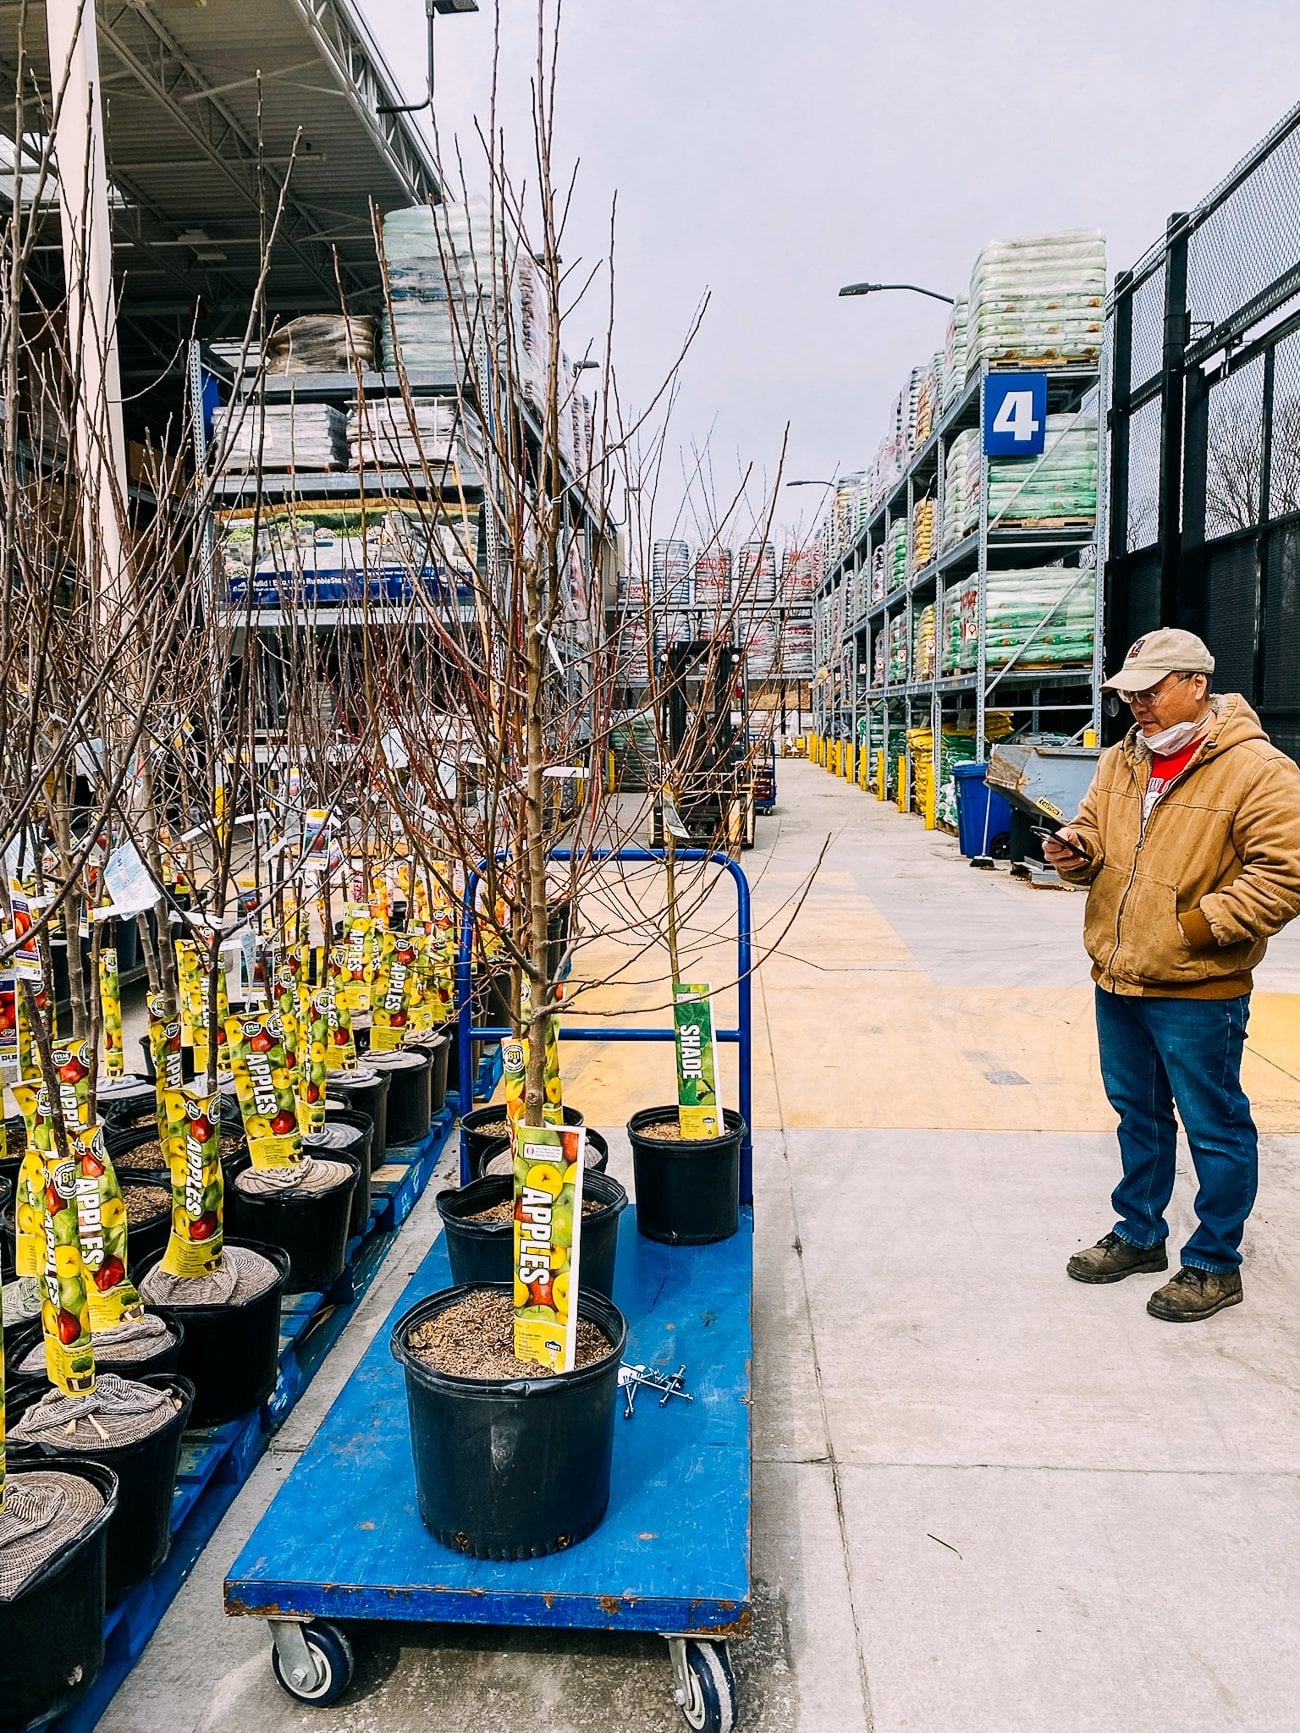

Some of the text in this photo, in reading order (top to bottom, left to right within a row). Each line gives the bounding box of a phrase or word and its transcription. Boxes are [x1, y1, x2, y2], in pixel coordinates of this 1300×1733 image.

[993, 391, 1040, 441] 4
[384, 961, 406, 1012] APPLES
[508, 1051, 519, 1060] 811
[680, 1024, 703, 1080] SHADE
[247, 1053, 278, 1115] APPLES
[185, 1134, 202, 1216] APPLES
[519, 1184, 554, 1287] APPLES
